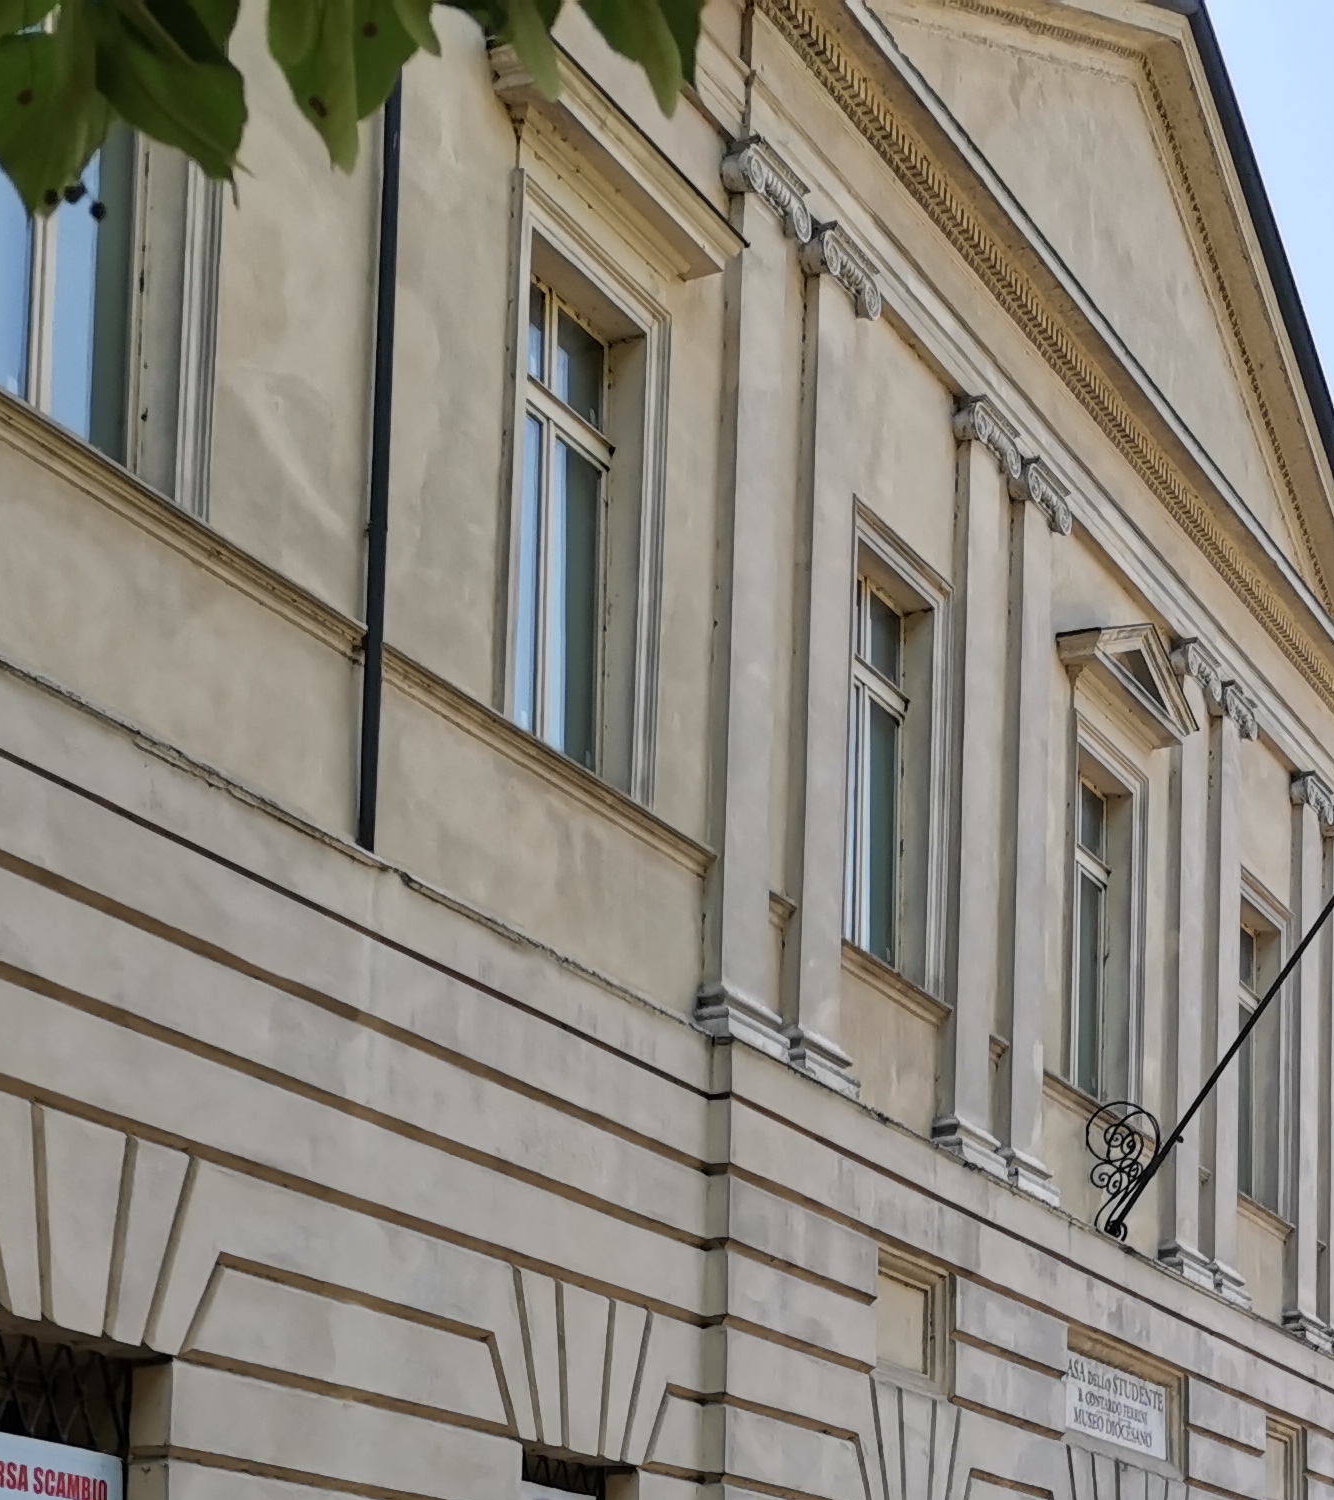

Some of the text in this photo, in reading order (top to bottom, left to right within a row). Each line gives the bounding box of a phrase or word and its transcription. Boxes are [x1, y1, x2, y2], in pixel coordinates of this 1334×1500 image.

[1113, 1374, 1163, 1413] STUDENTE
[1074, 1407, 1153, 1448] MUSEO DIOCESANO
